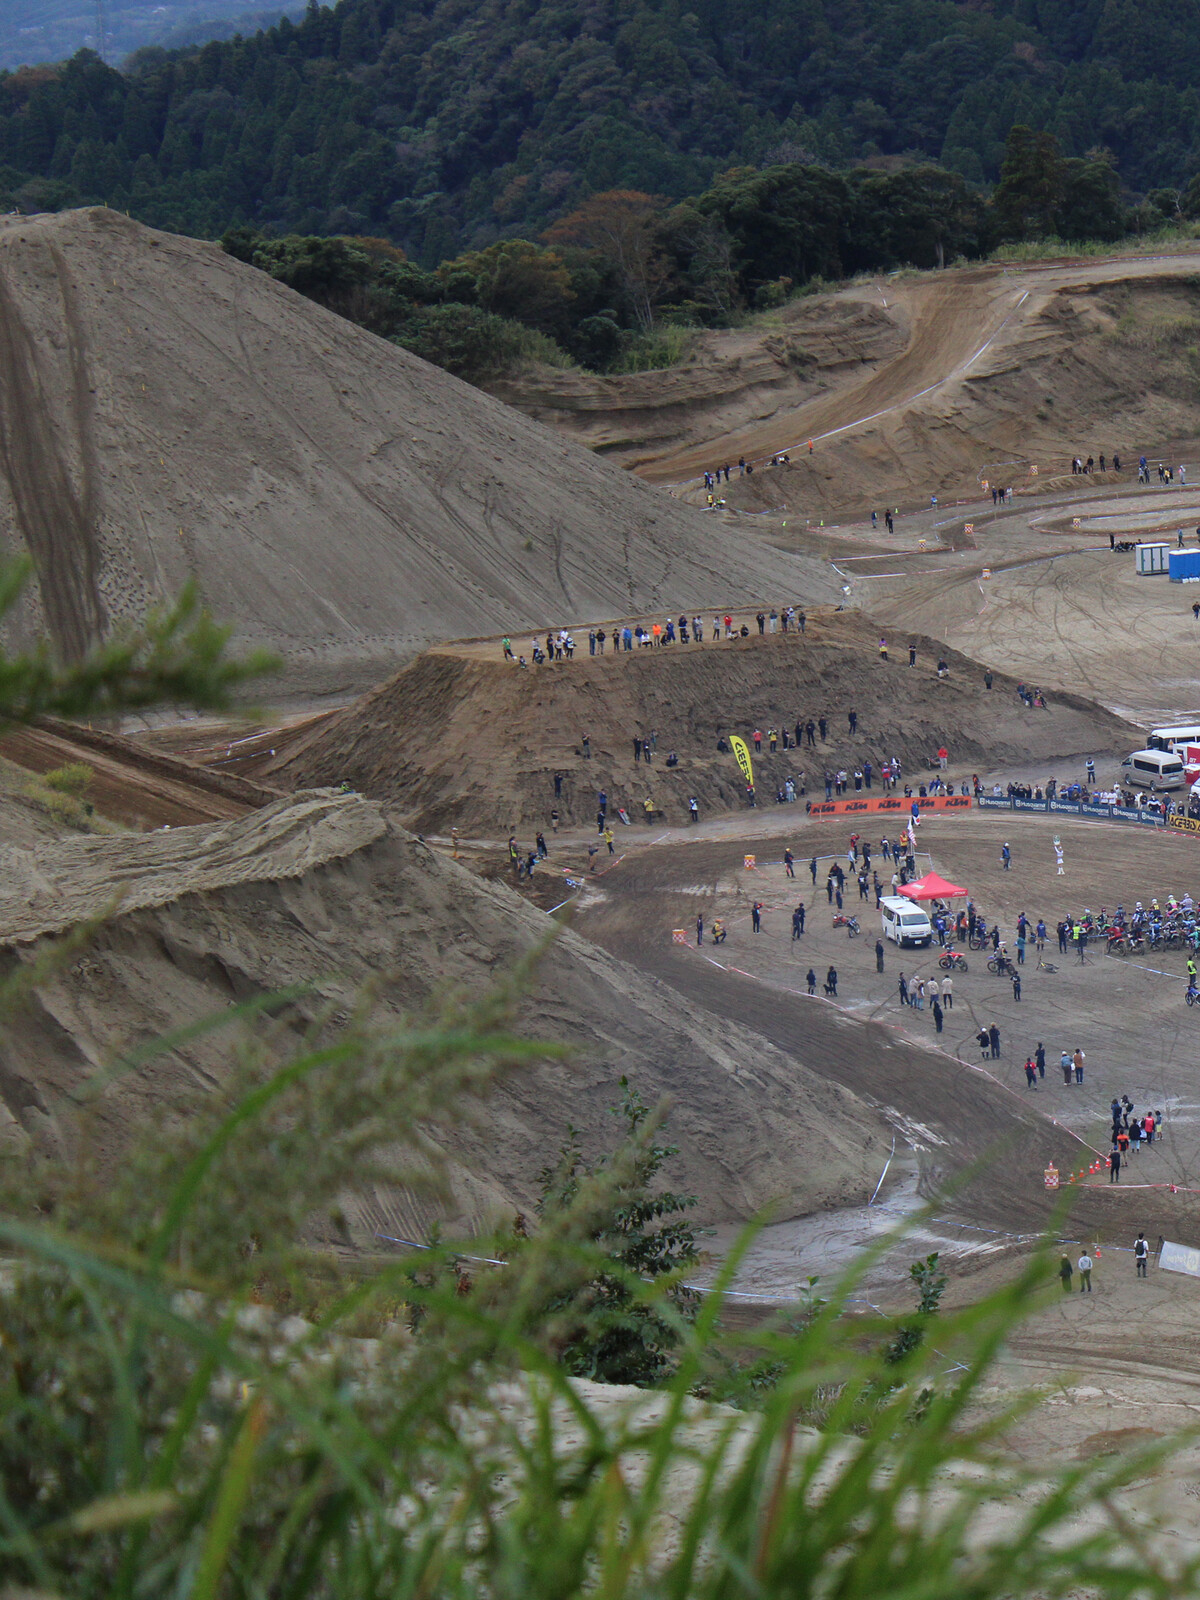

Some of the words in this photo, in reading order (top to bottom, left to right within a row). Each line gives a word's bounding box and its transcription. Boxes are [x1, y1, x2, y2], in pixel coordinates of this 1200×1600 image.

[845, 801, 868, 811] KTM
[878, 799, 901, 809] KTM
[945, 797, 969, 807] KTM
[1056, 803, 1079, 811] Husqvarna
[813, 803, 836, 814] KTM
[1117, 809, 1139, 817] Husqvarna
[1169, 816, 1196, 830] ACERBIS
